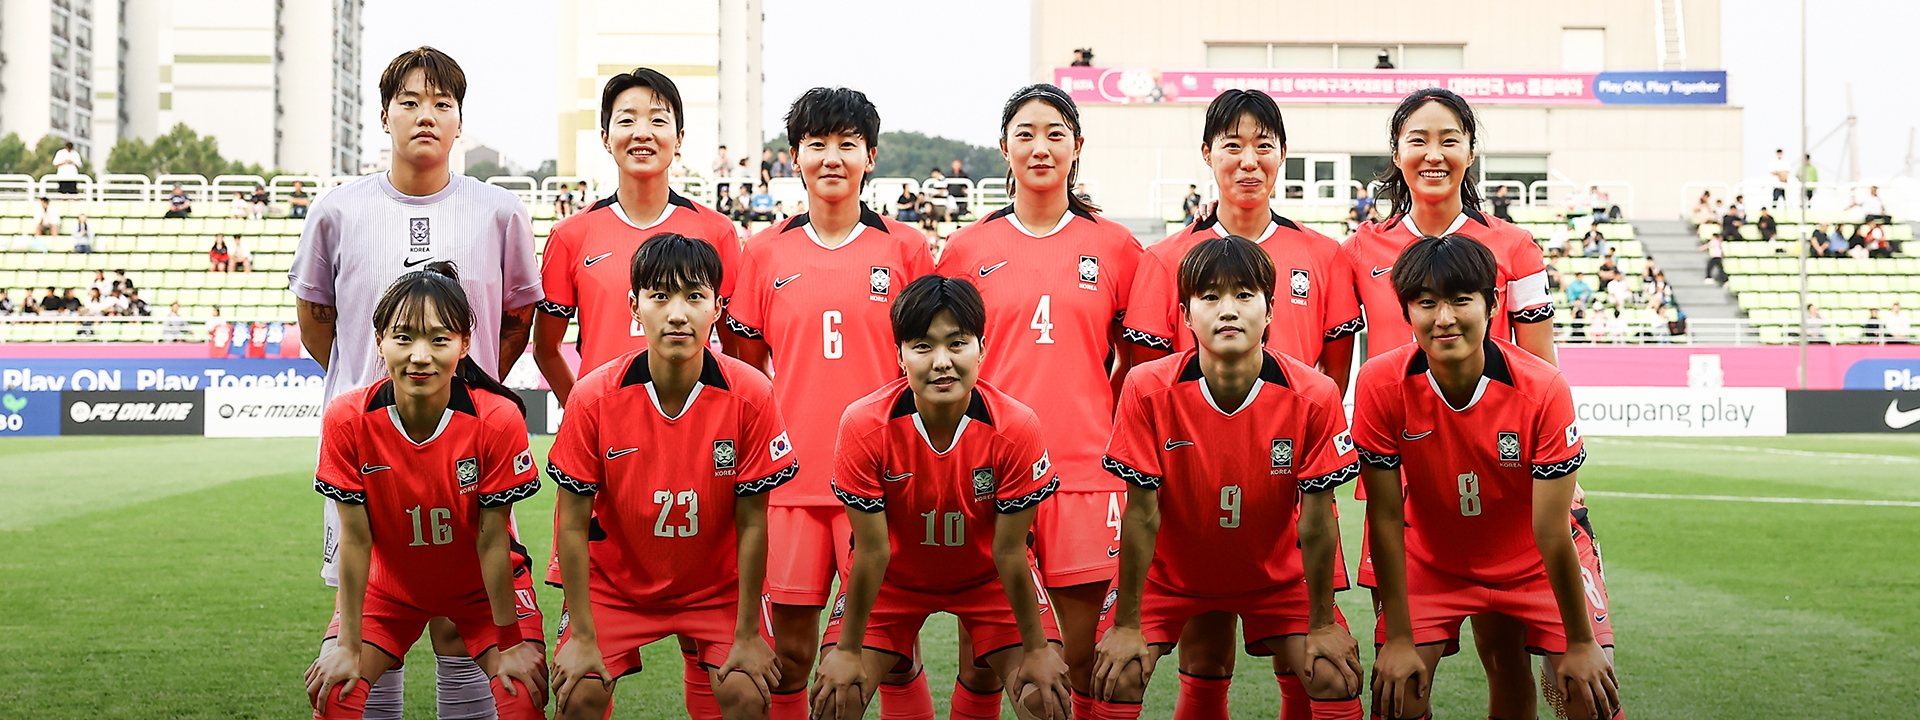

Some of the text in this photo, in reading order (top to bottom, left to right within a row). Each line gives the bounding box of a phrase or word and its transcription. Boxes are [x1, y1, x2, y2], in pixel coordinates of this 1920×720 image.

[1447, 77, 1504, 96] 대한민국
[1506, 81, 1526, 95] vs
[1598, 80, 1622, 95] Play
[1646, 80, 1671, 95] Play
[1671, 80, 1721, 96] Together
[869, 295, 888, 303] KOREA
[1078, 283, 1098, 292] KOREA
[1290, 298, 1308, 307] KOREA
[822, 310, 843, 359] 6
[1030, 294, 1055, 344] 4
[116, 402, 194, 421] ONLINE
[237, 404, 263, 418] FC
[1577, 397, 1755, 428] coupang play
[714, 469, 737, 477] KOREA
[1219, 484, 1242, 529] 9
[1457, 470, 1482, 517] 8
[405, 504, 454, 547] 16
[653, 488, 699, 538] 23
[920, 508, 965, 547] 10
[1107, 491, 1121, 541] 4
[1580, 565, 1605, 610] 8
